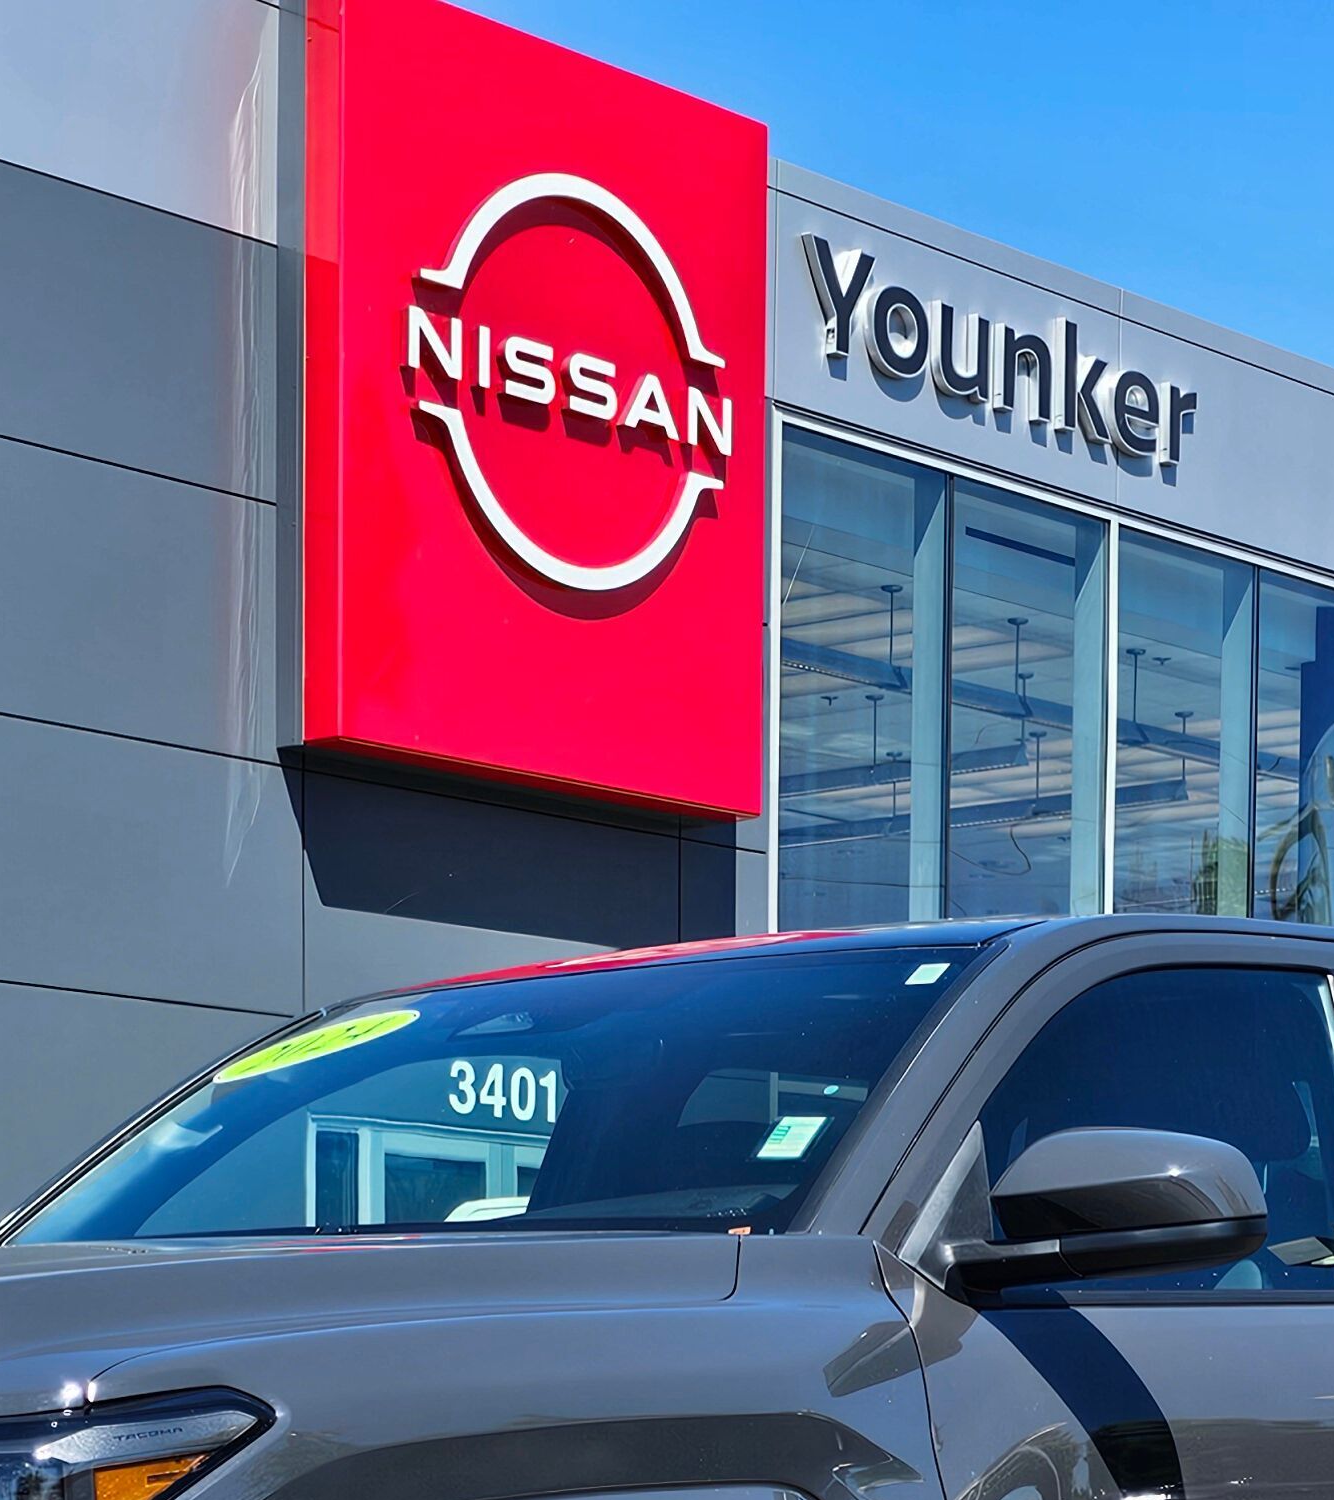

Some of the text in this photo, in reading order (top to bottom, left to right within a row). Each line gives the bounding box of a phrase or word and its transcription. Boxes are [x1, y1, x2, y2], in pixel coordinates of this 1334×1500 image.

[406, 305, 733, 457] NISSAN
[801, 232, 1197, 466] Younker
[449, 1060, 556, 1123] 3401
